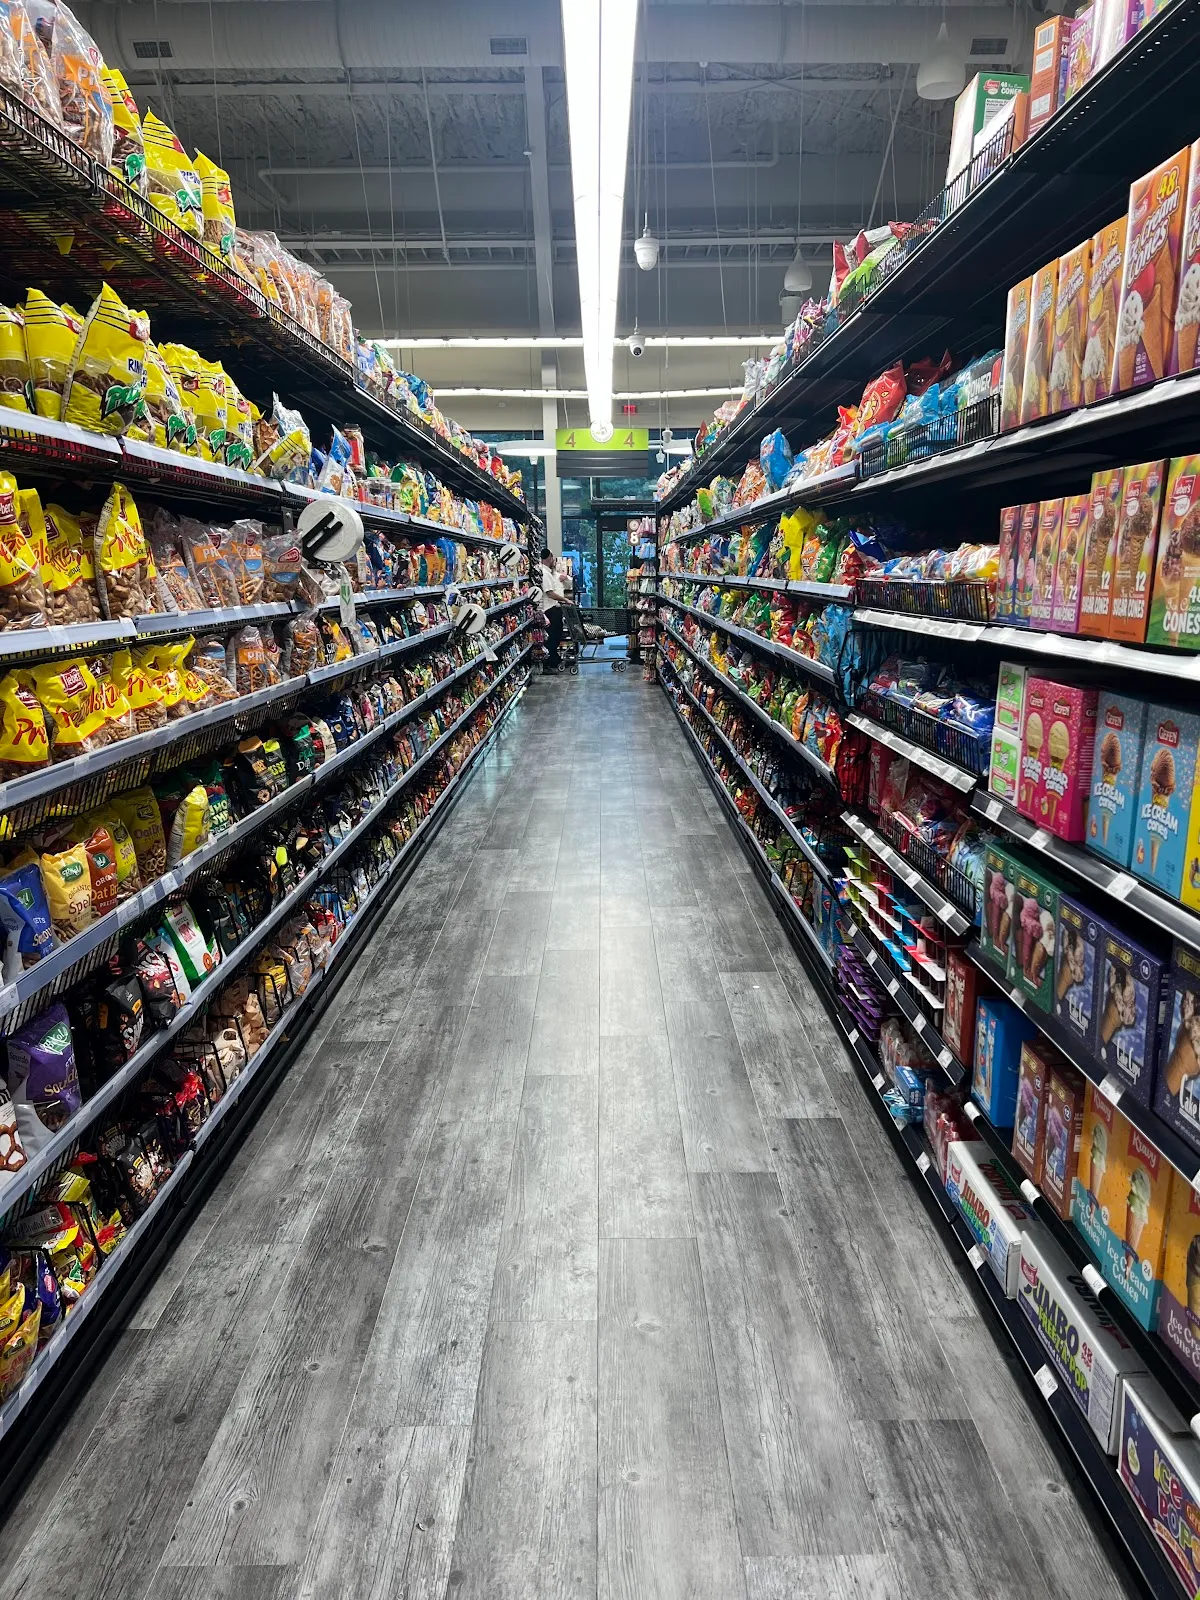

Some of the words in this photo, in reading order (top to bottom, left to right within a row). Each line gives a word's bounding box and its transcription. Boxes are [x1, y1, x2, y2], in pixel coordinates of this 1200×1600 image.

[1158, 168, 1178, 198] 48
[565, 432, 576, 447] 4
[623, 432, 634, 447] 4
[630, 531, 639, 544] 8
[1101, 571, 1111, 590] 12
[1136, 571, 1147, 591] 12
[1163, 610, 1200, 635] CONES
[1054, 702, 1070, 716] GEFEN
[1106, 712, 1122, 726] GEFEN
[1158, 726, 1177, 744] GEFEN
[1022, 756, 1042, 774] SUGAR
[1043, 767, 1068, 789] SUGAR
[1046, 779, 1065, 796] cones
[1098, 797, 1117, 815] cones
[1101, 784, 1125, 809] CREAM
[1142, 804, 1153, 820] ICE
[1151, 806, 1178, 835] CREAM
[1147, 819, 1168, 840] cones
[95, 873, 118, 887] ORGAN
[68, 894, 92, 916] Spel
[1180, 1073, 1198, 1119] Cake
[960, 1178, 990, 1228] JUMBO
[1081, 1213, 1101, 1248] Cones
[1107, 1240, 1120, 1264] Ice
[1119, 1257, 1149, 1300] Cream
[1143, 1264, 1152, 1279] 24
[1112, 1263, 1139, 1304] Cones
[1024, 1277, 1080, 1356] JUMBO
[1167, 1322, 1191, 1358] Cone
[1170, 1309, 1183, 1335] Ice
[1183, 1328, 1200, 1355] Cre
[1156, 1490, 1200, 1573] POPS
